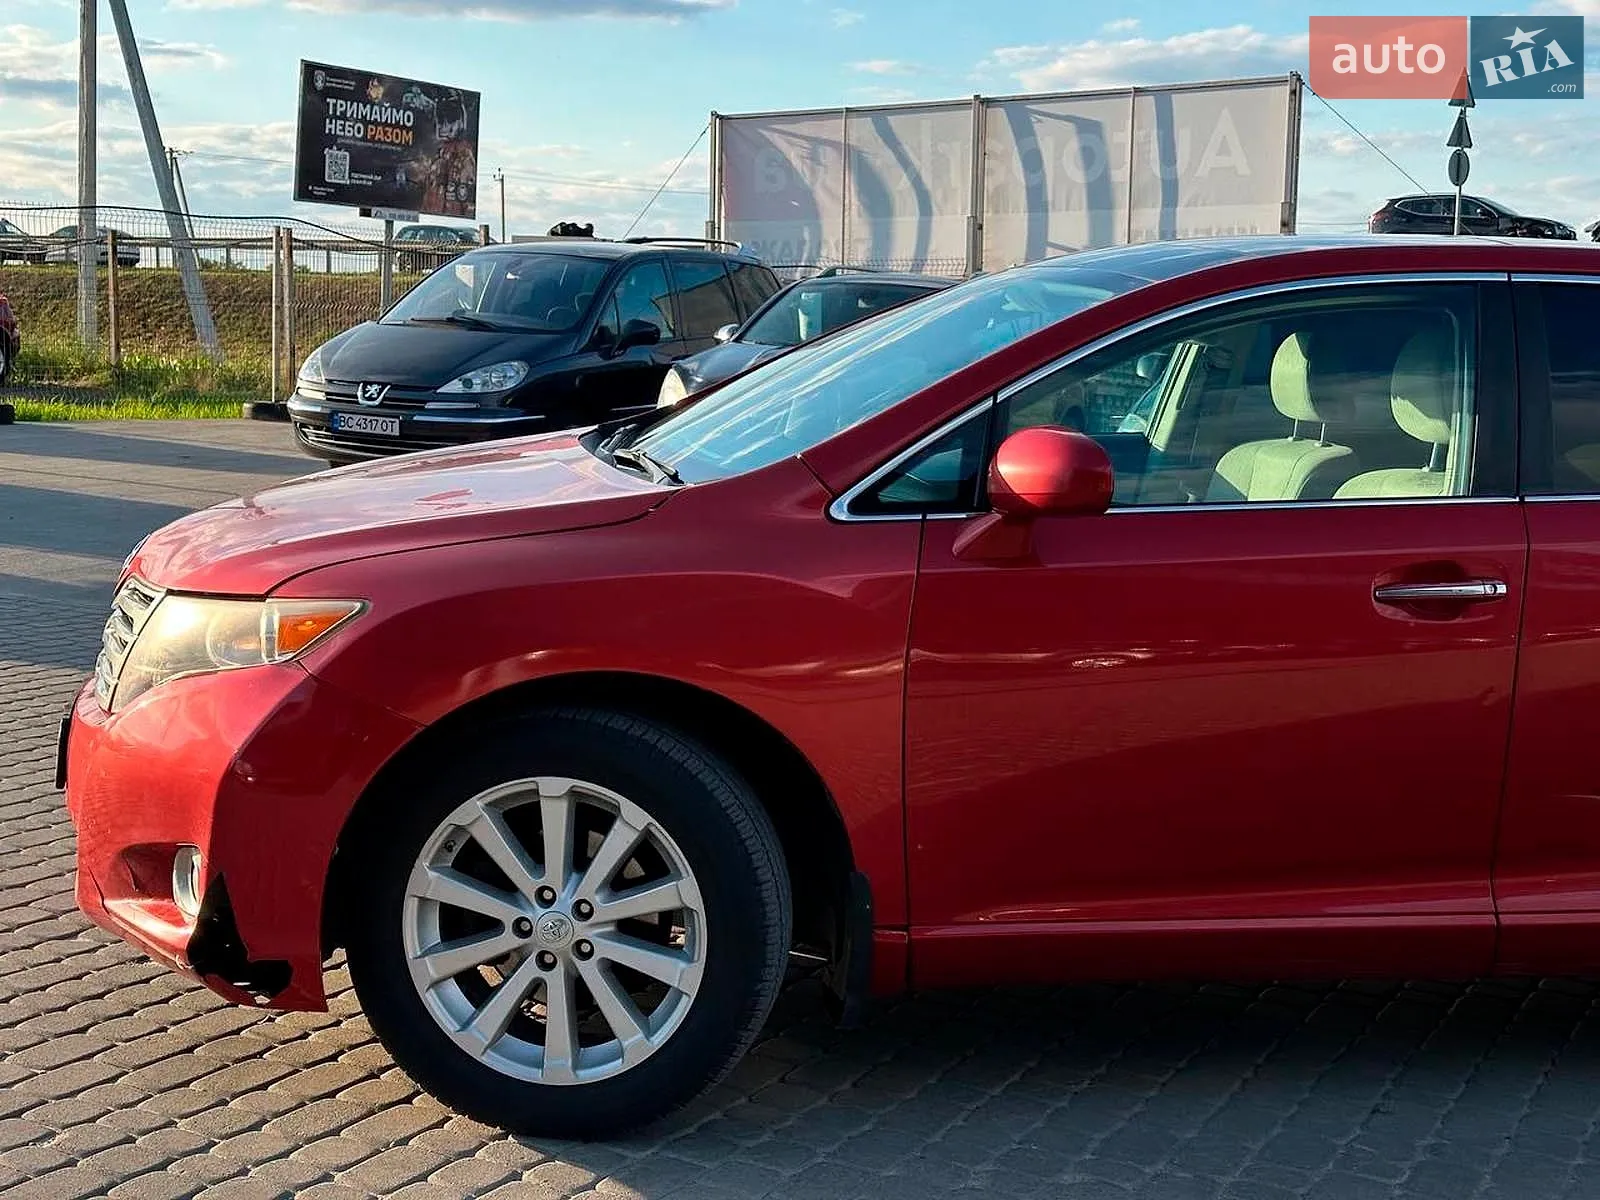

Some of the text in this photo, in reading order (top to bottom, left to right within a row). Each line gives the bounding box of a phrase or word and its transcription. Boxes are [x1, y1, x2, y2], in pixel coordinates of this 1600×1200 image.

[326, 98, 414, 127] ТРИМАЙМО
[324, 118, 364, 138] НЕБО
[366, 126, 413, 146] РАЗОМ
[339, 416, 396, 433] BC 4317 OT
